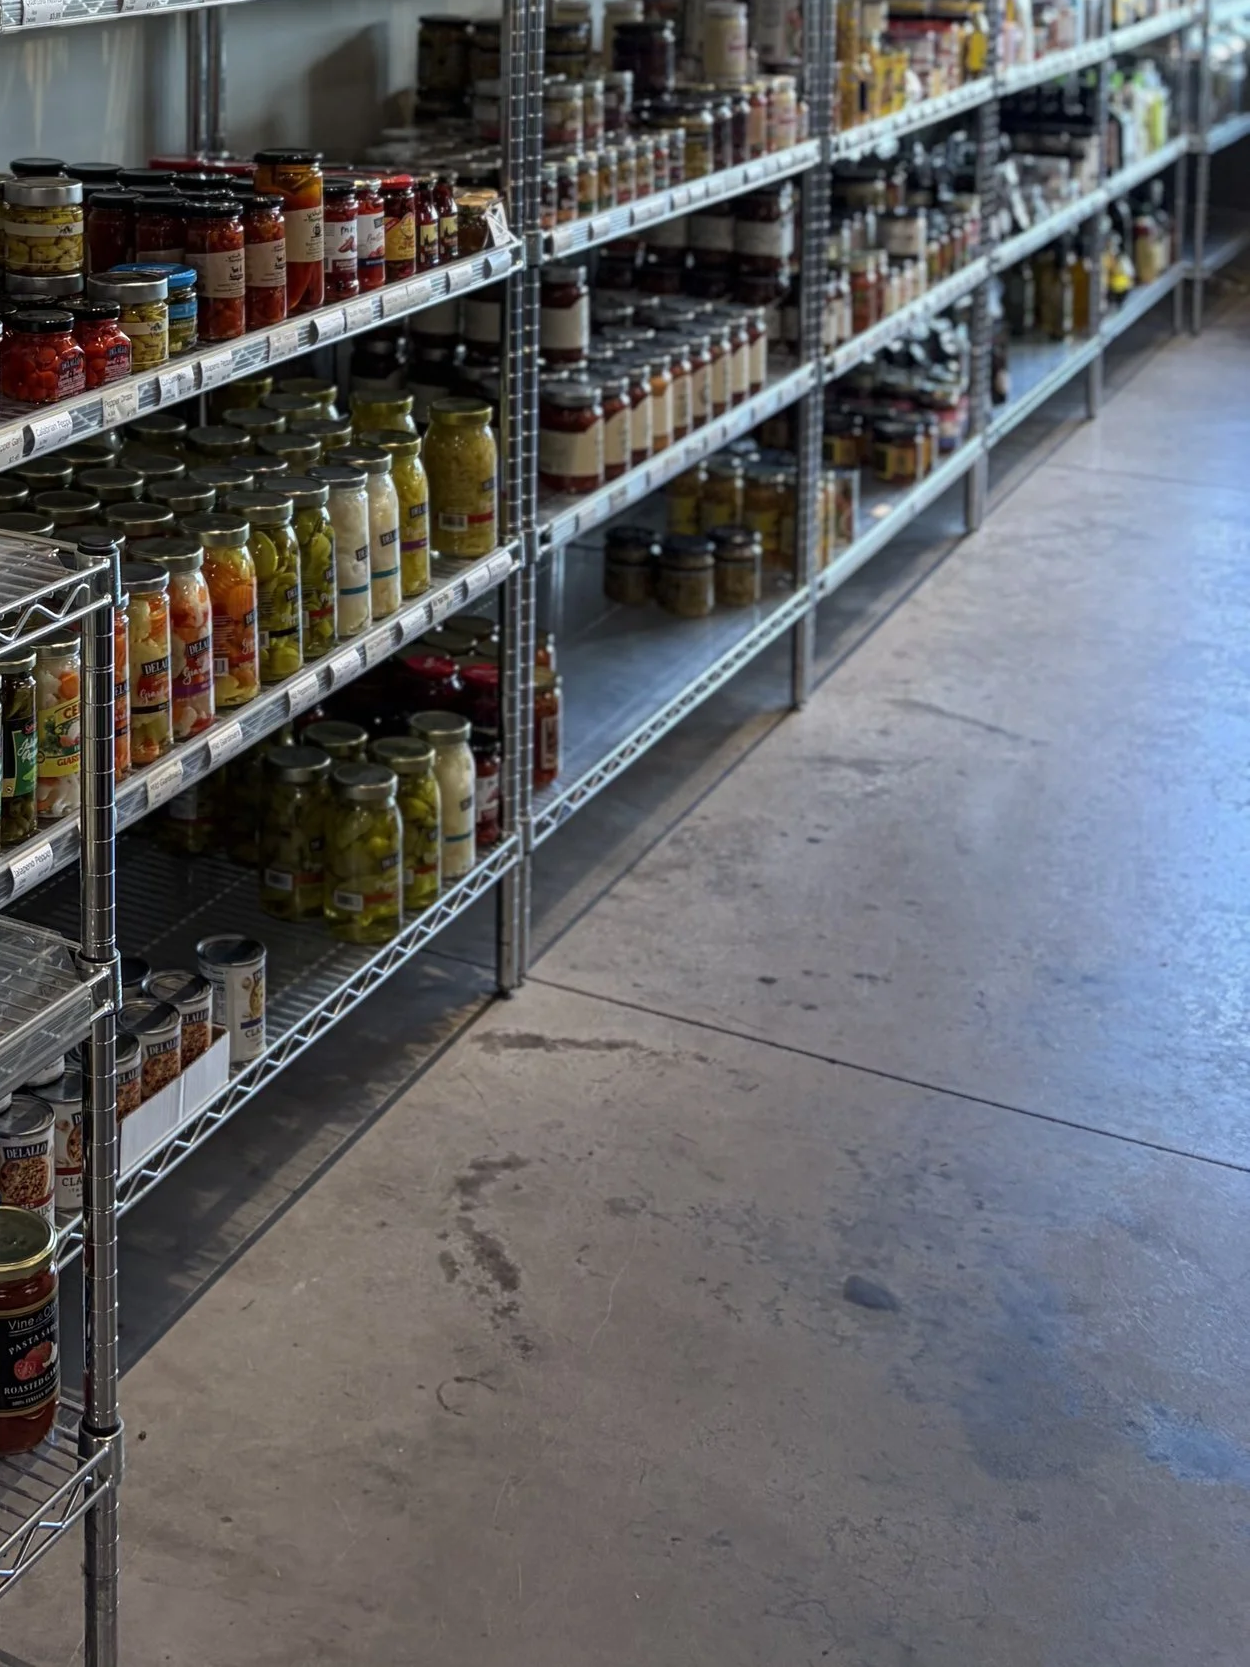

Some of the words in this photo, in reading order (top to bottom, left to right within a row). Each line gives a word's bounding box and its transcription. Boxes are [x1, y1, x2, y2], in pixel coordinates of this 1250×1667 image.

[7, 1144, 48, 1159] DELALLO
[8, 1318, 35, 1331] Vine
[8, 1335, 39, 1356] PASTA
